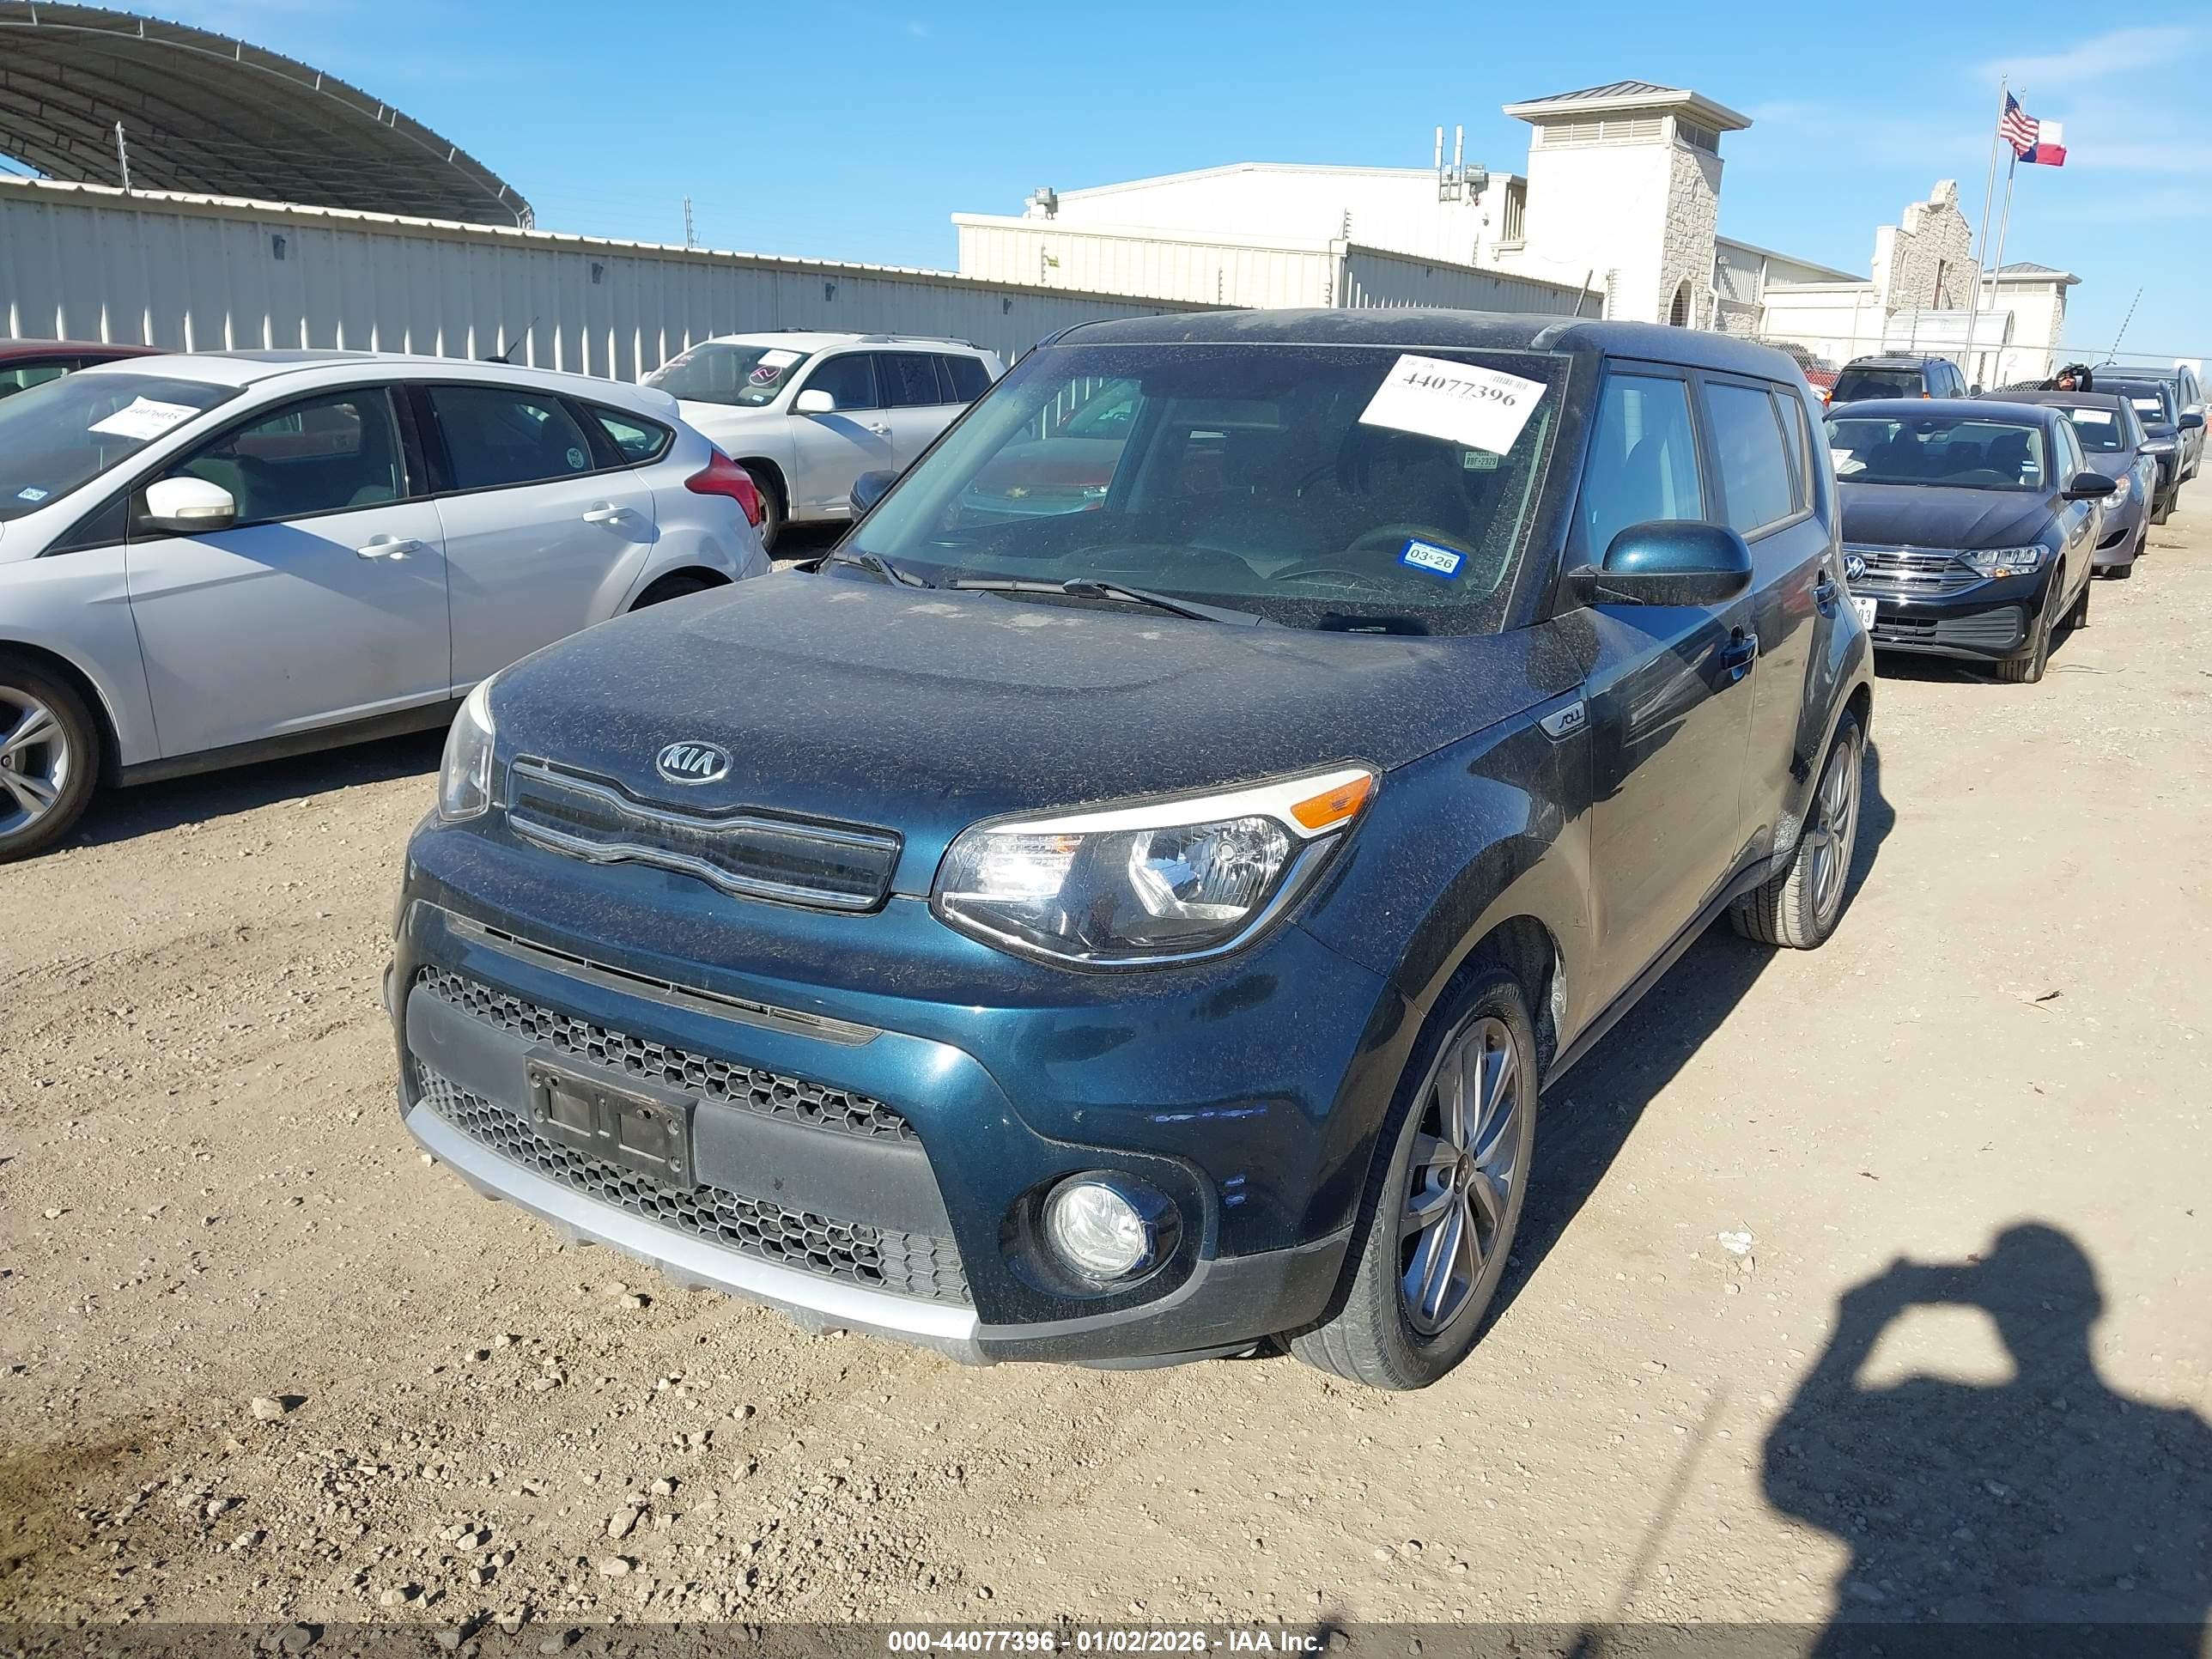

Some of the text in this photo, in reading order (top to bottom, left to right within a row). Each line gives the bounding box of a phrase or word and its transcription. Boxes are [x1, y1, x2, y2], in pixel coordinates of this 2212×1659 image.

[2006, 354, 2018, 368] 2
[1403, 373, 1516, 406] 44077396
[1410, 549, 1429, 561] 03
[1434, 556, 1453, 568] 26
[663, 745, 715, 775] KIA
